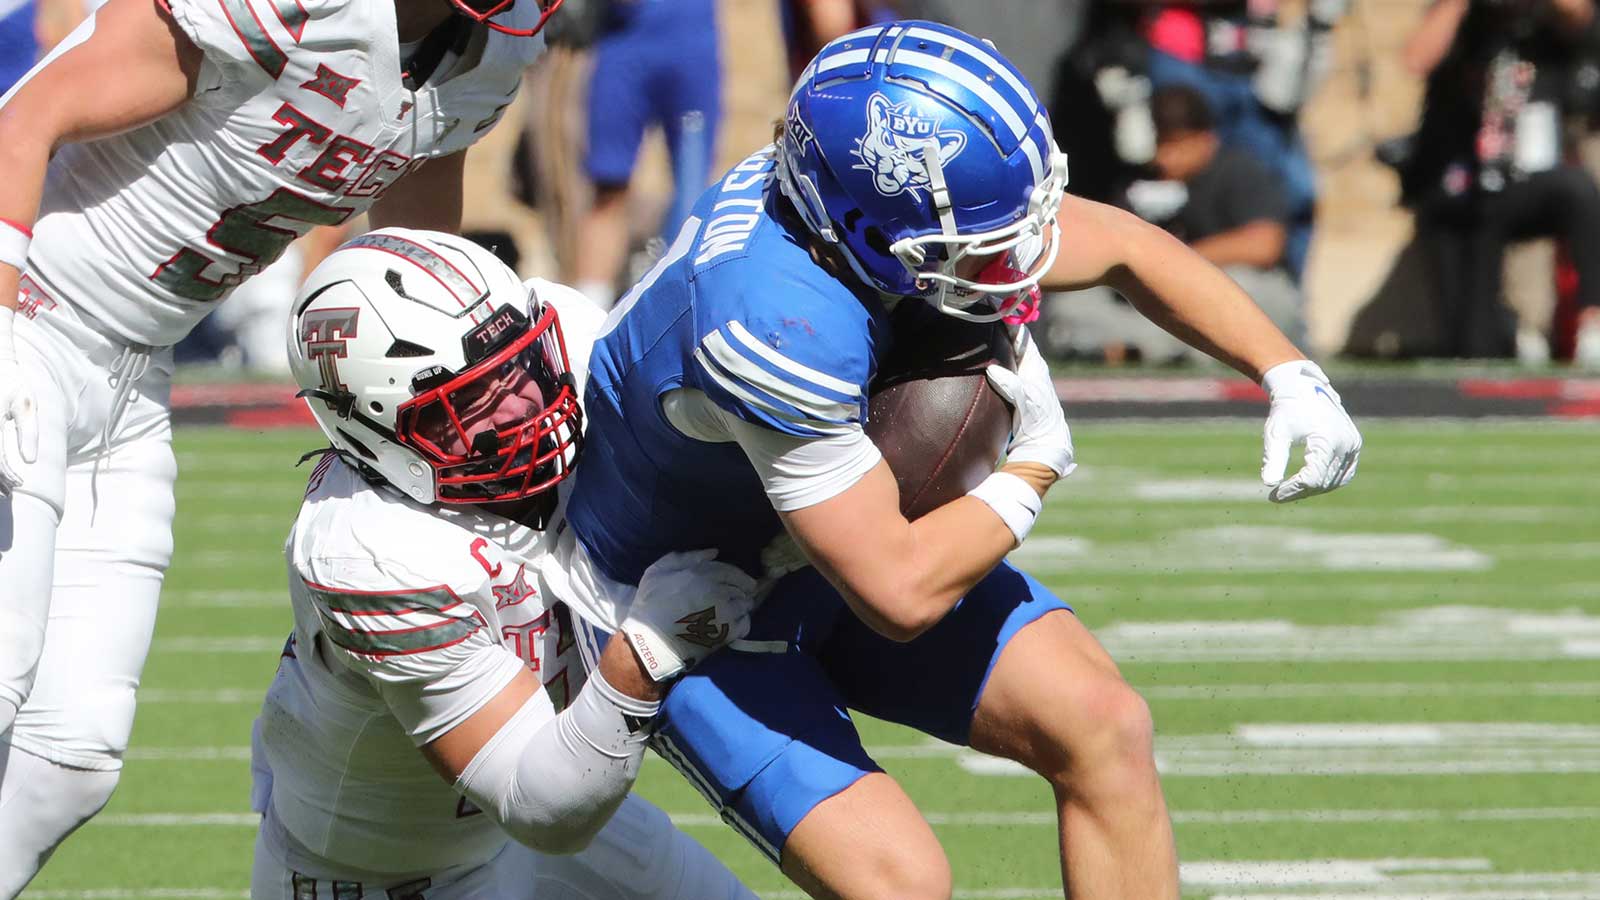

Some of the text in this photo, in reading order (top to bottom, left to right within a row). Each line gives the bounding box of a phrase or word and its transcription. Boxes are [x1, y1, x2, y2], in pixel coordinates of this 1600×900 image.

[893, 116, 930, 135] BYU
[257, 102, 428, 198] TEC
[149, 185, 356, 302] 5
[476, 312, 514, 344] TECH
[432, 366, 443, 375] UP
[470, 536, 503, 580] C
[633, 633, 658, 670] ADIZERO
